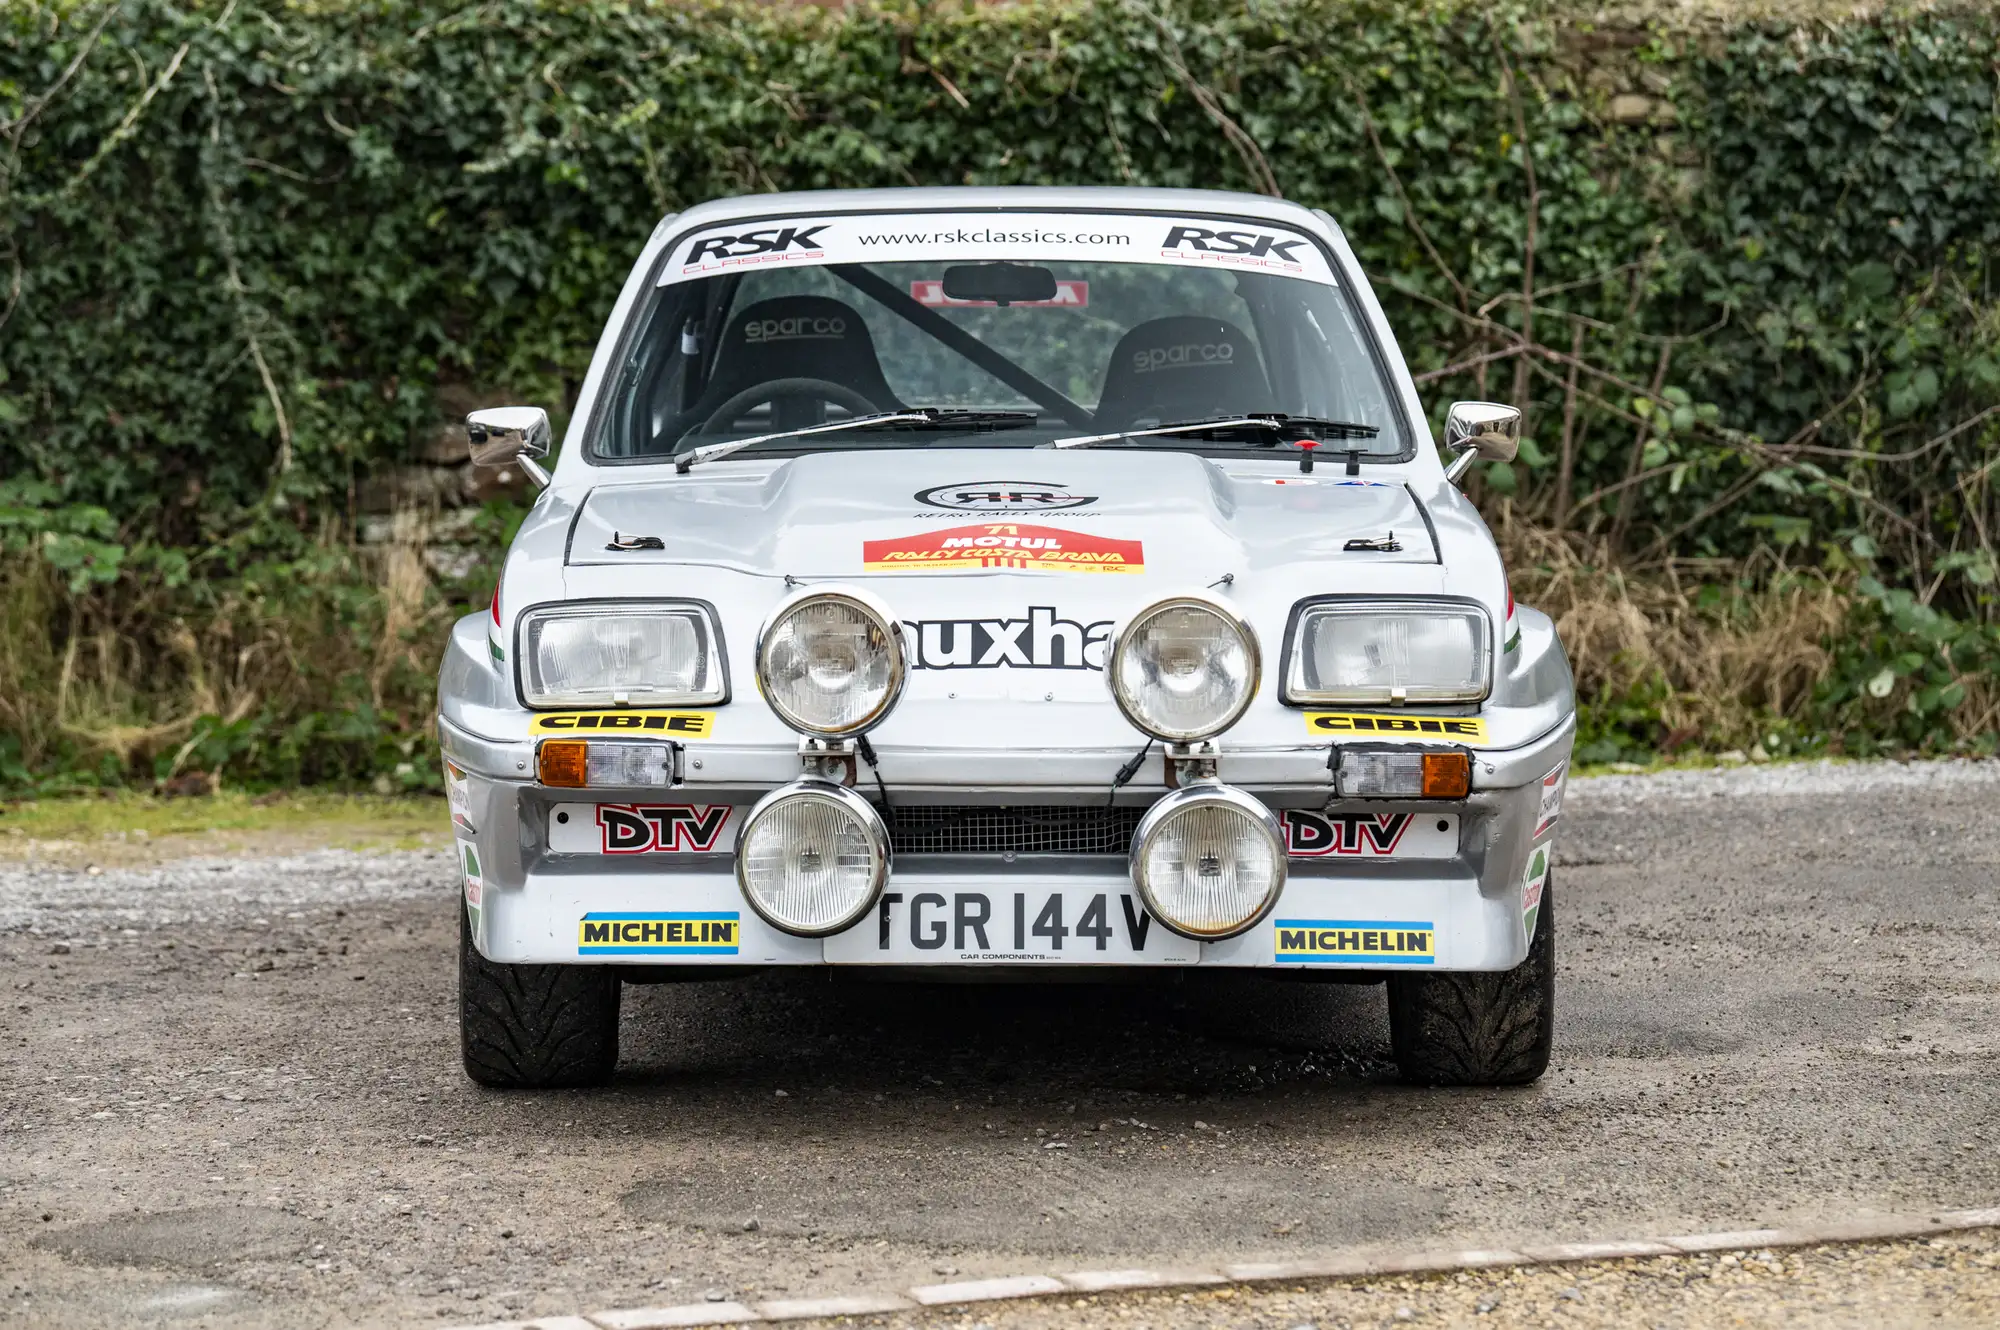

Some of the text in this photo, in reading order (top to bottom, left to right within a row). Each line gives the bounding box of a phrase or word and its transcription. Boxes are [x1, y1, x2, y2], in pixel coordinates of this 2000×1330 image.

[684, 225, 832, 265] RSK
[858, 229, 1130, 245] www.rskclassics.com
[1162, 226, 1309, 263] RSK
[683, 251, 824, 274] CLASSICS
[1161, 251, 1302, 272] CLASSICS
[745, 318, 846, 342] sparco
[1133, 343, 1234, 373] sparco
[984, 525, 1018, 535] 71
[941, 536, 1062, 549] MOTUL
[882, 548, 1125, 562] RALLY COSTA BRAVA
[598, 806, 729, 852] DTV
[1284, 810, 1412, 852] DTV
[584, 923, 732, 942] MICHELIN
[879, 893, 1151, 951] TGR 144V
[1280, 930, 1427, 951] MICHELIN
